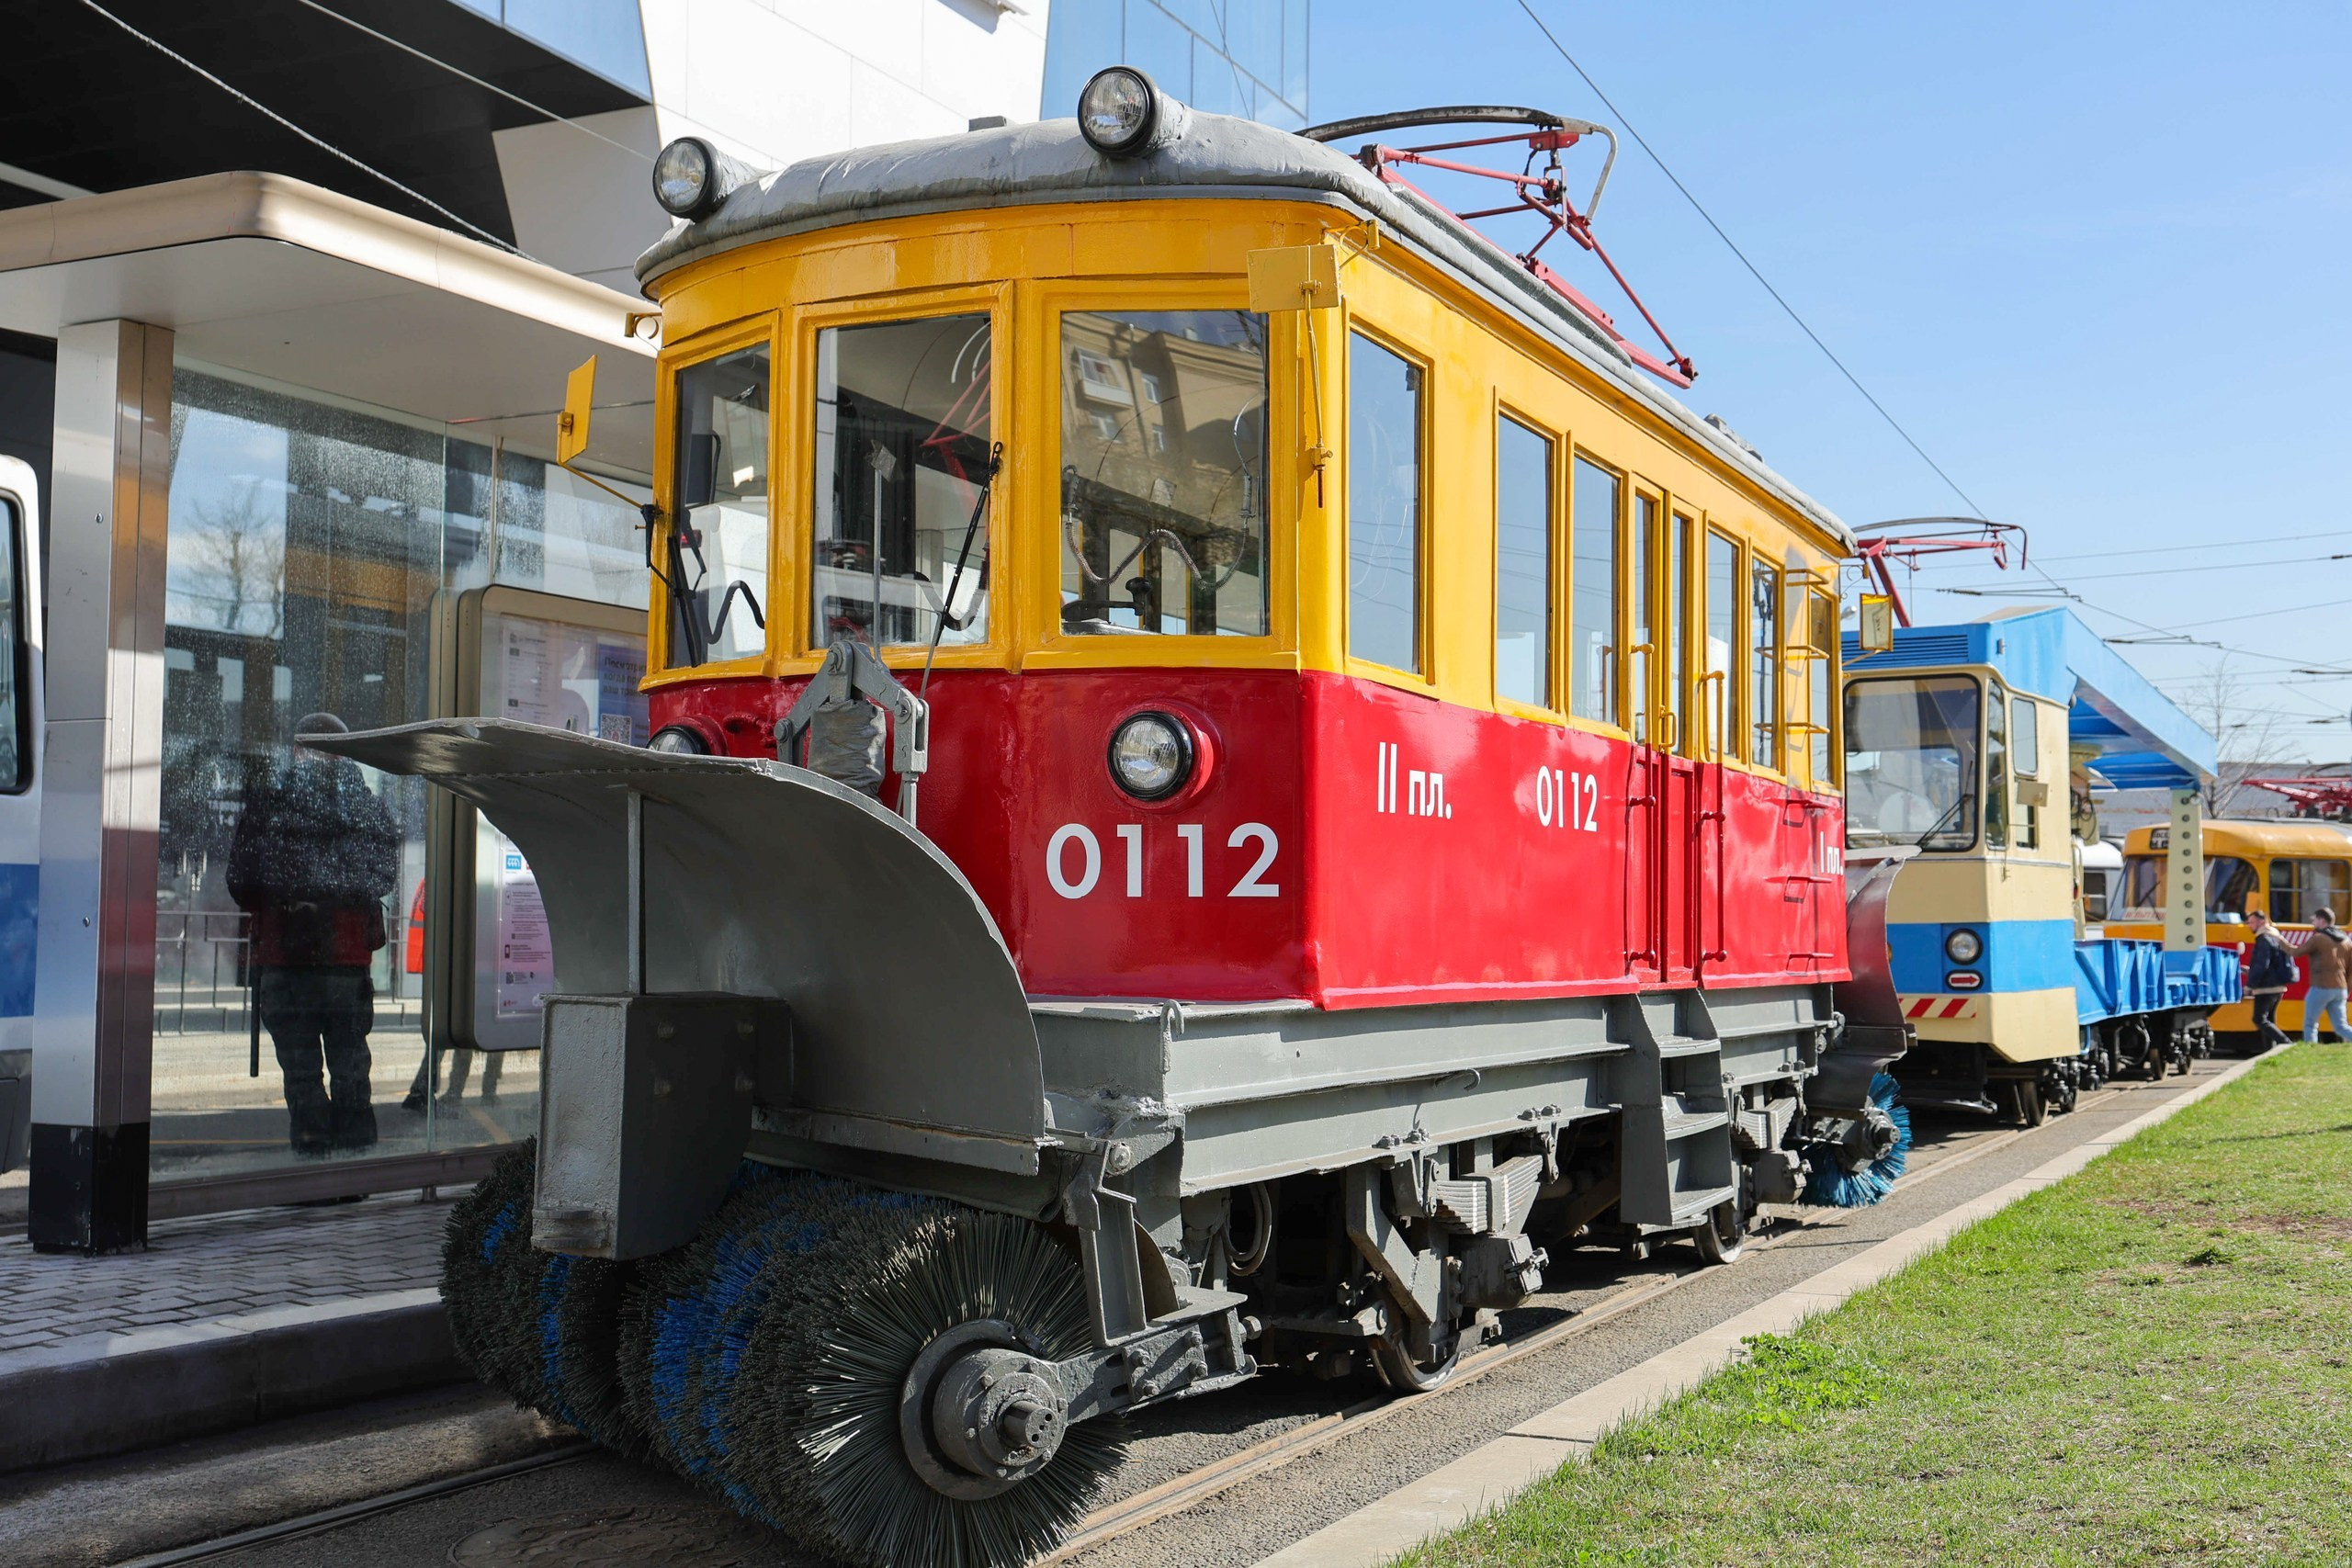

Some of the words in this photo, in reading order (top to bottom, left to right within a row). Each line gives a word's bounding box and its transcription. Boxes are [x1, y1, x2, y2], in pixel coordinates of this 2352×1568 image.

[1408, 770, 1452, 819] пл.
[1536, 765, 1598, 832] 0112
[1046, 822, 1280, 899] 0112
[1826, 846, 1844, 875] пл.
